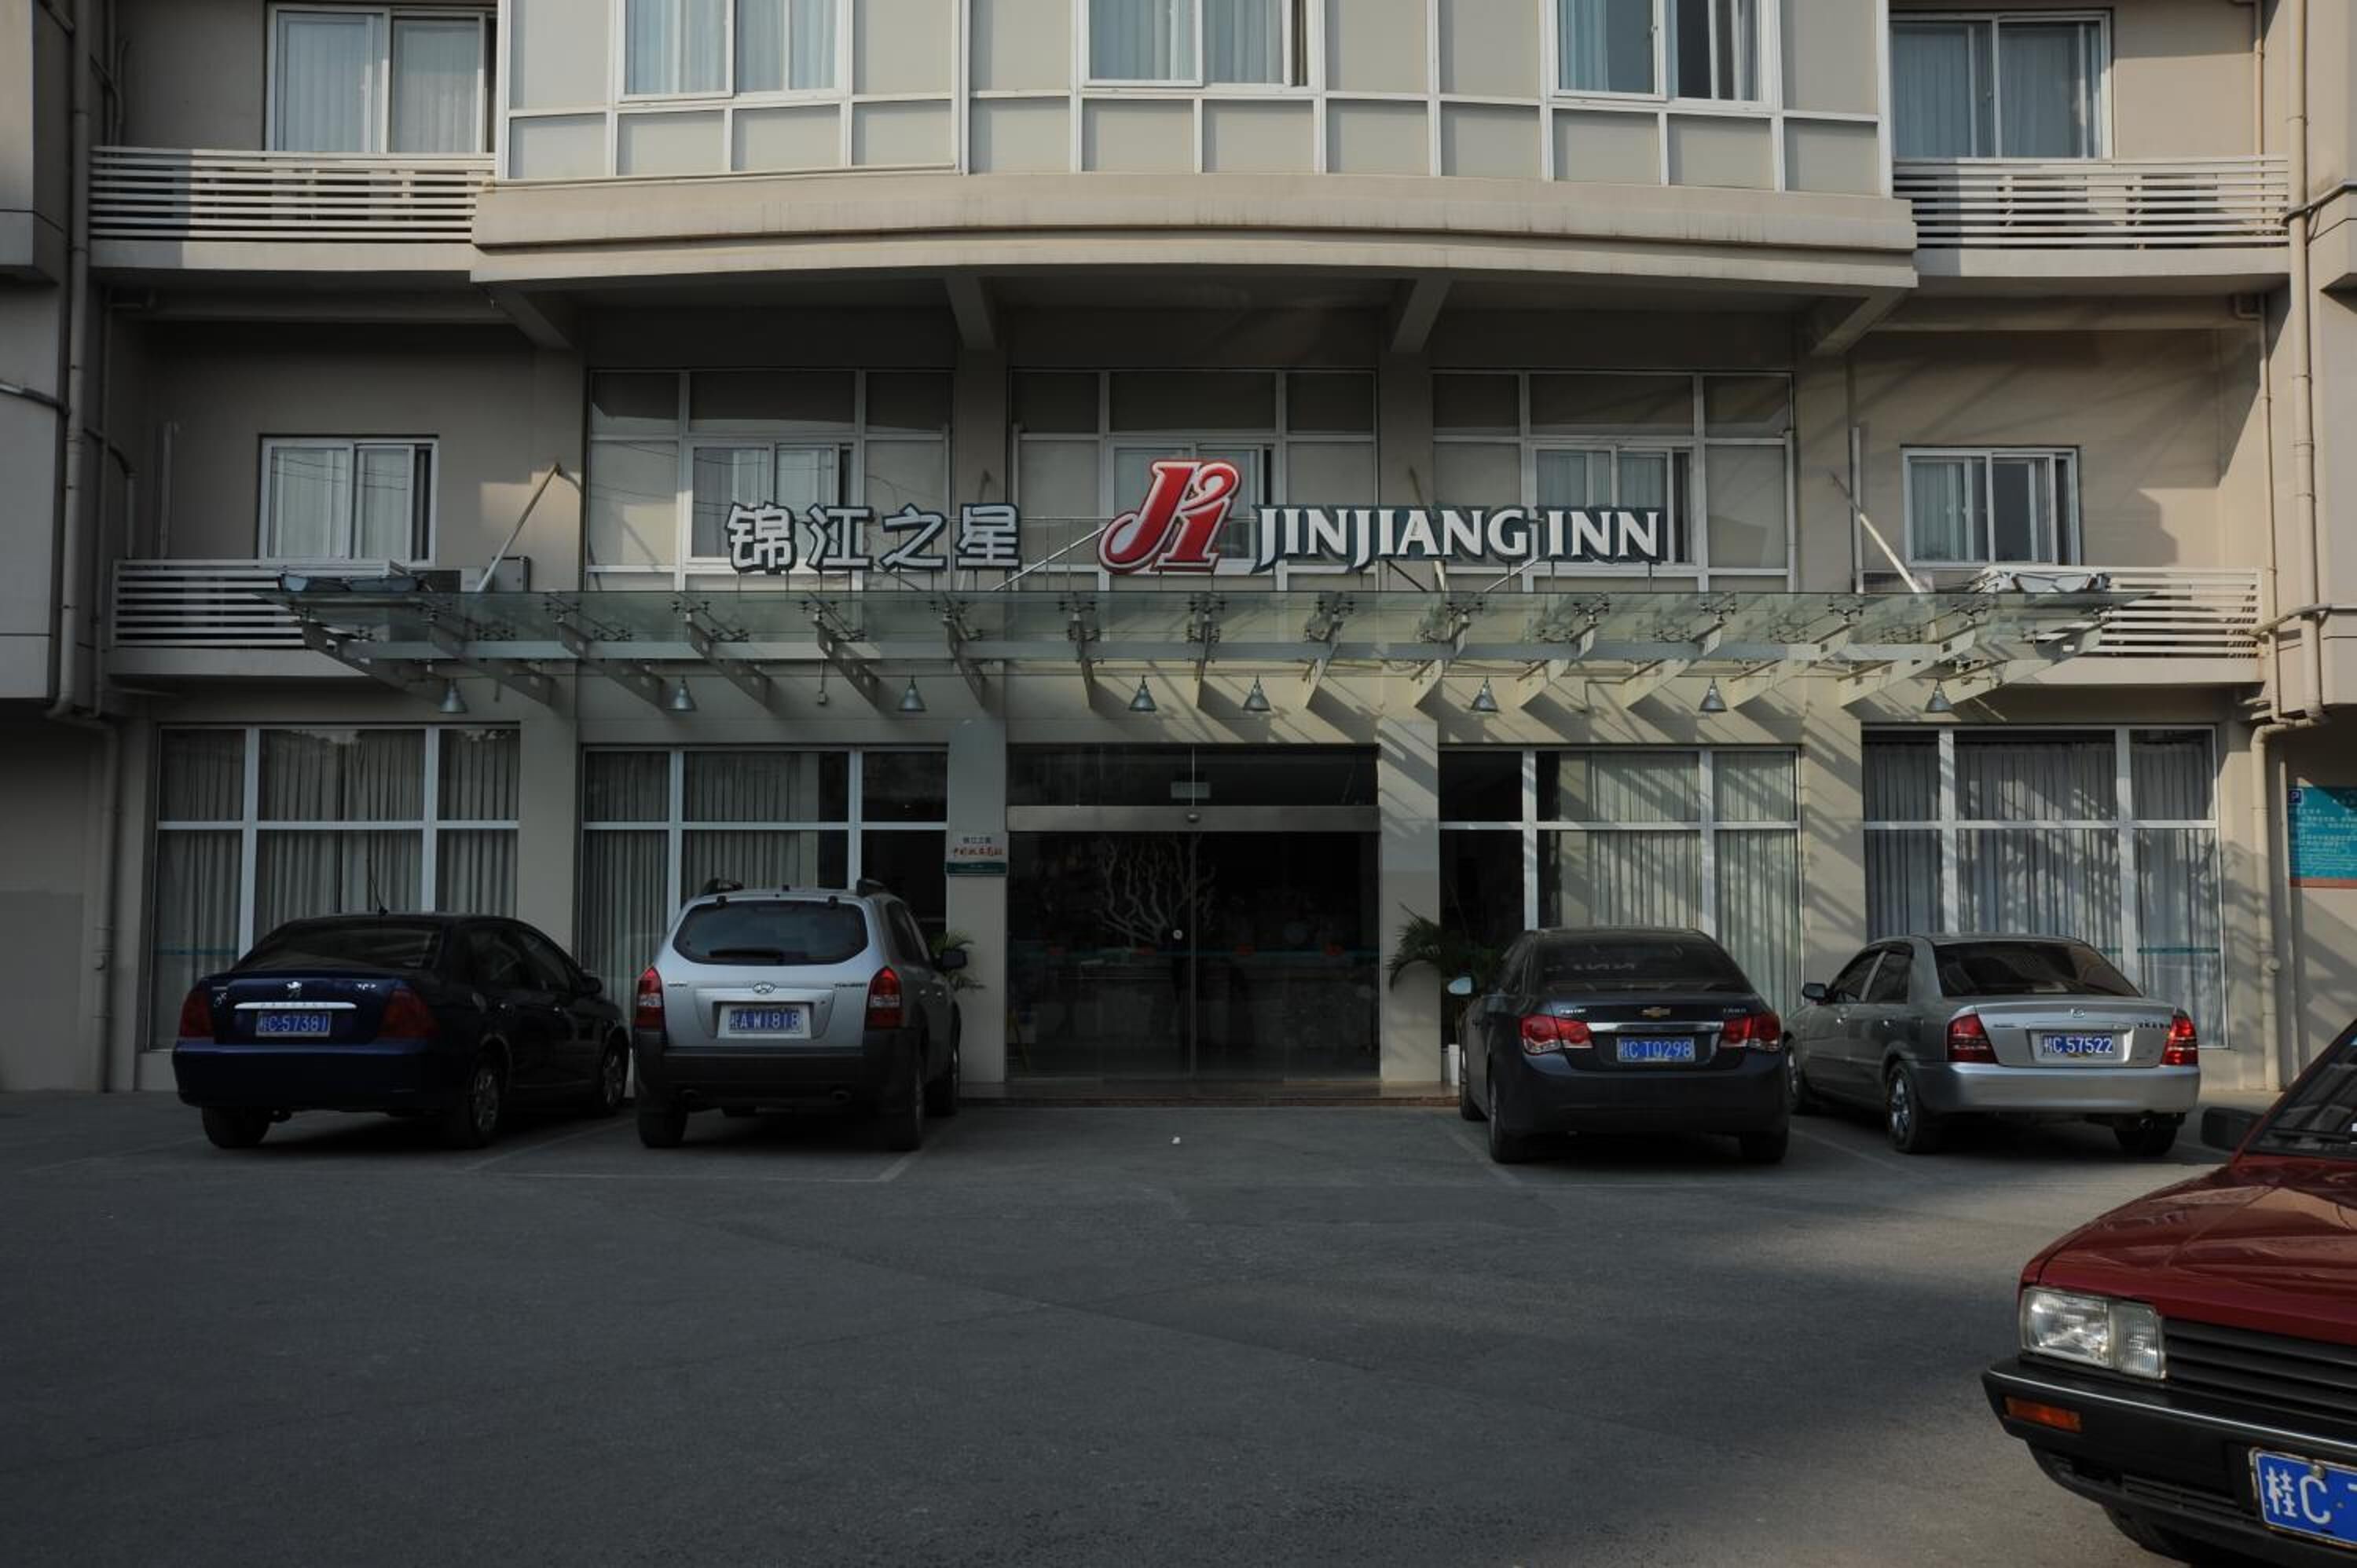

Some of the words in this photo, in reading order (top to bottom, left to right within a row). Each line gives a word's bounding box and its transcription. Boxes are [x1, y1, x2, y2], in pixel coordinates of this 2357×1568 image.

[726, 503, 1020, 573] 锦江之星
[1254, 507, 1529, 570] JINJIANG
[1543, 508, 1662, 561] INN
